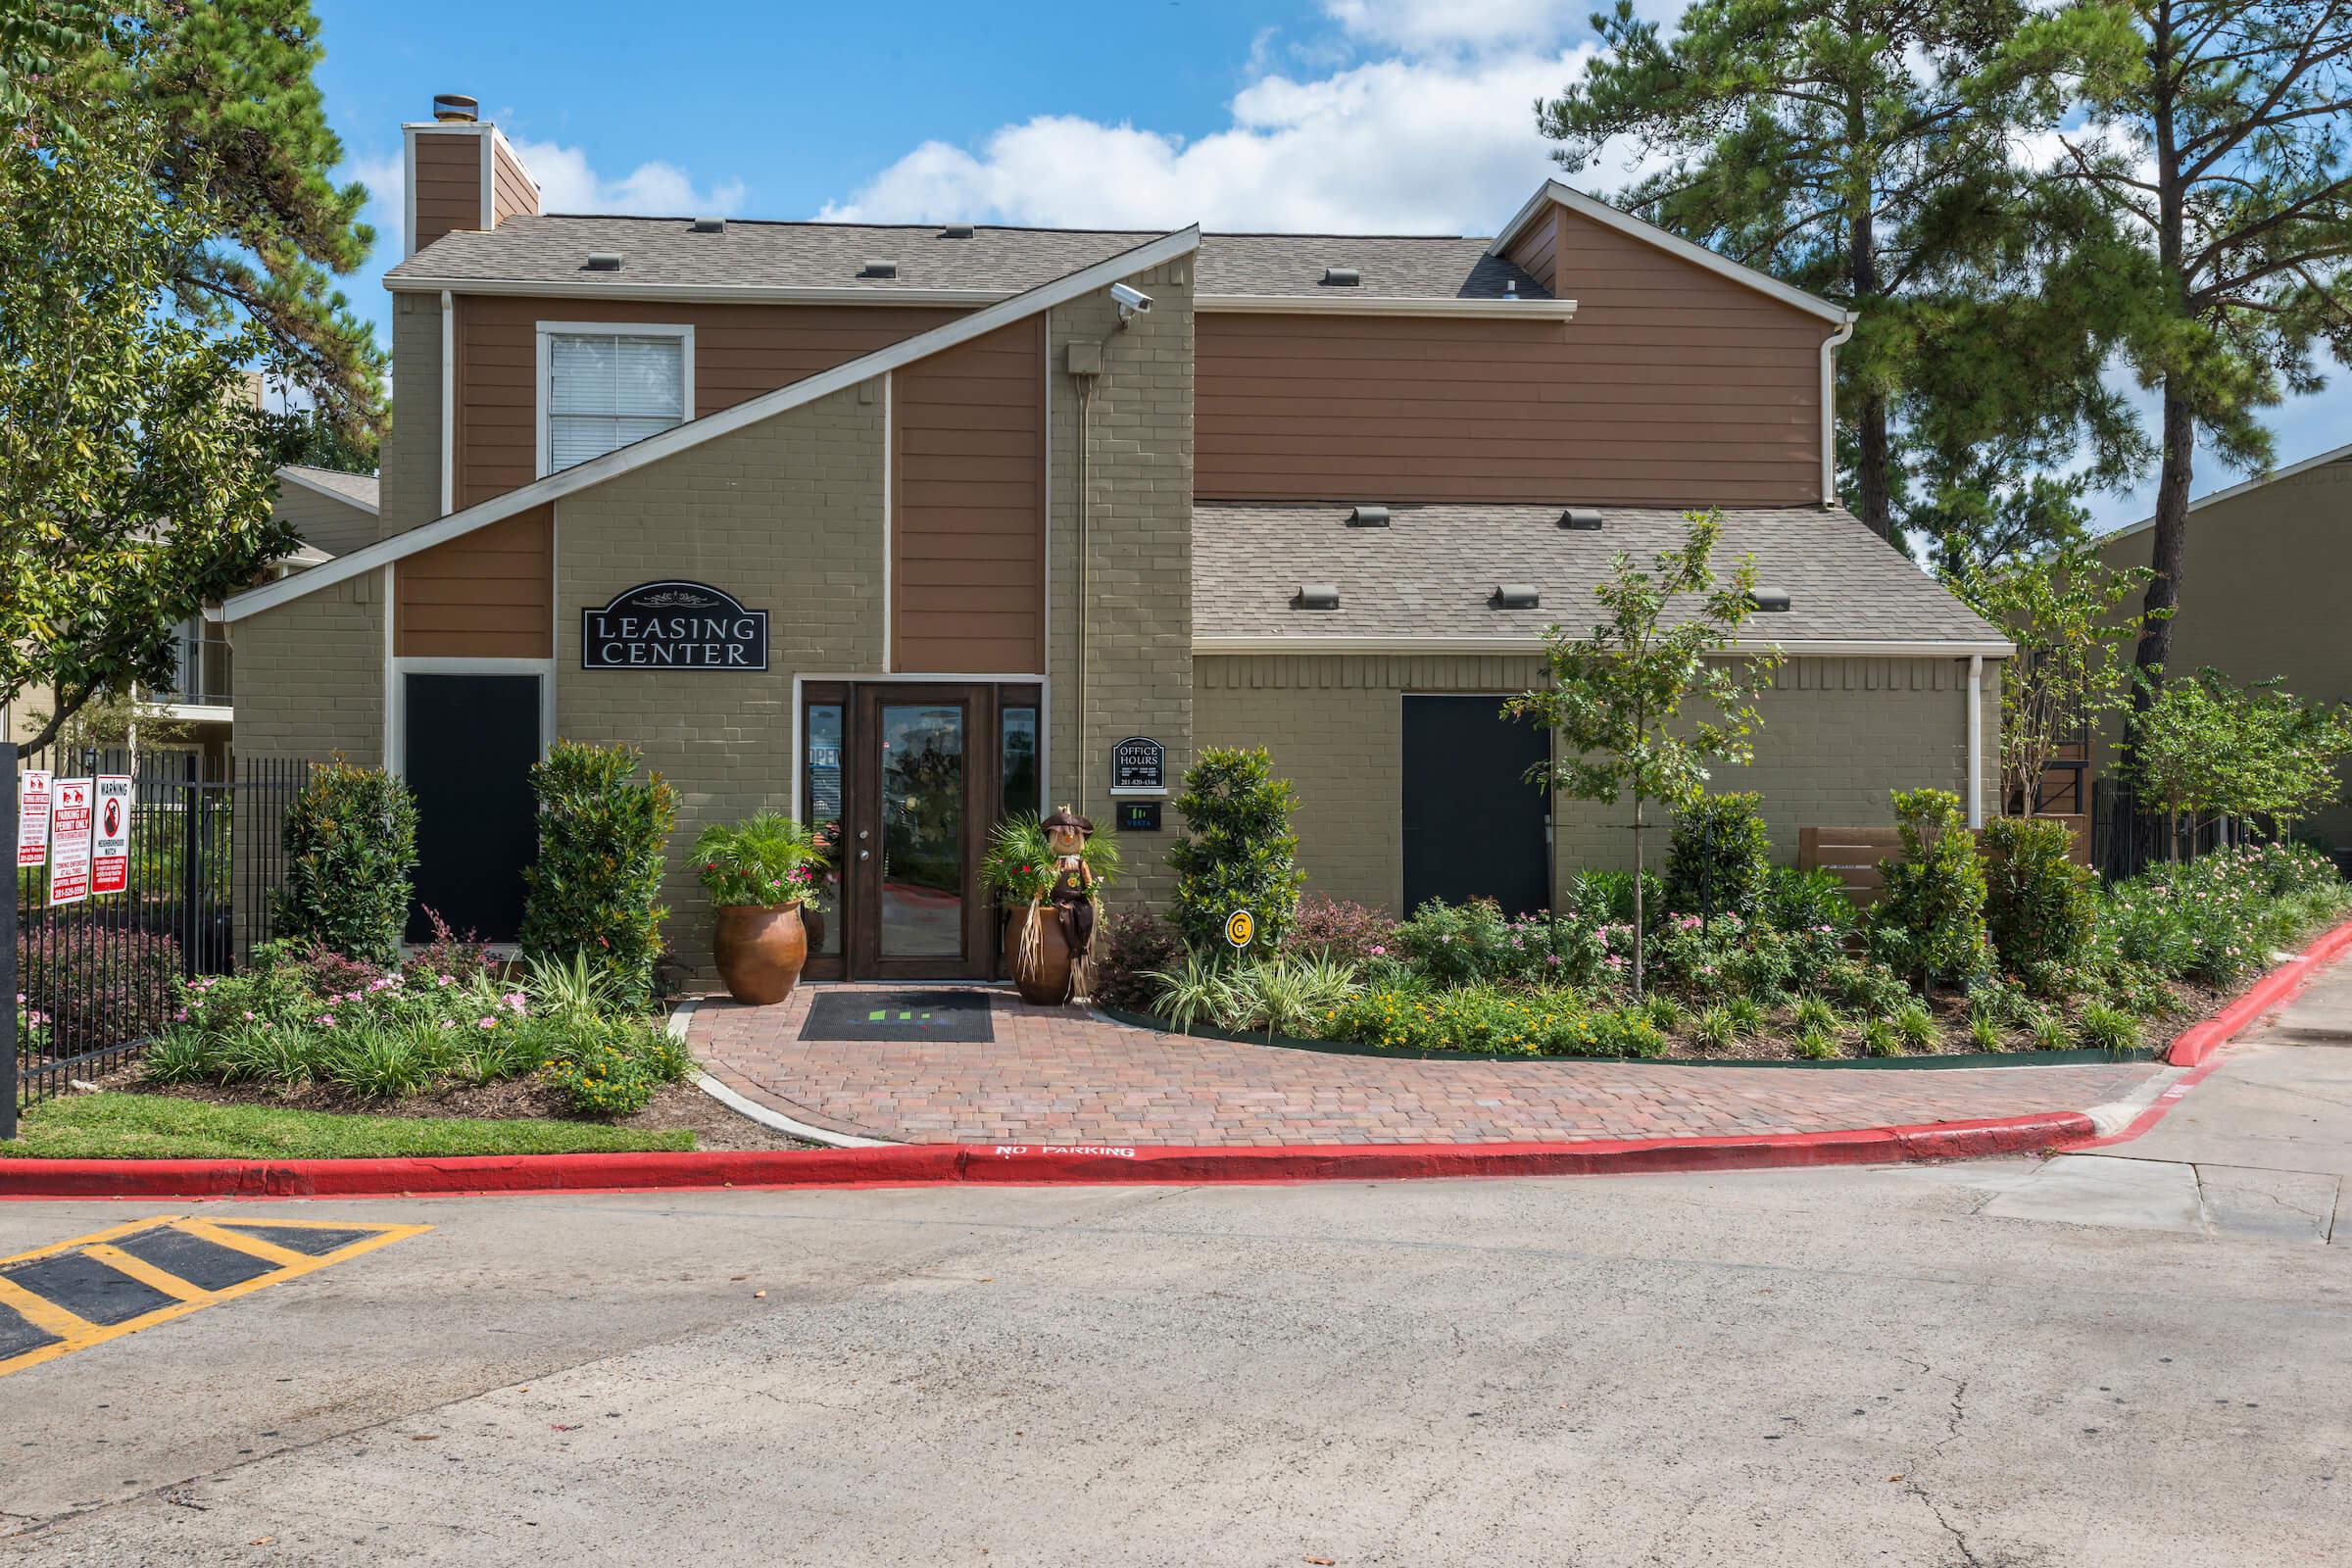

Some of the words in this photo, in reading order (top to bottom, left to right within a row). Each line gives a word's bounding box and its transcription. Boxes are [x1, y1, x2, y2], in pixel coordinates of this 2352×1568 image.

[597, 617, 755, 640] LEASING
[601, 643, 749, 665] CENTER
[1120, 746, 1158, 756] OFFICE
[1120, 756, 1158, 765] HOURS
[101, 782, 127, 796] WARNING
[57, 808, 79, 820] PARKING
[80, 808, 88, 818] BY
[56, 819, 74, 832] PERMIT
[75, 818, 88, 830] ONLY
[105, 847, 117, 856] WATCH
[996, 1146, 1027, 1155] NO
[1042, 1146, 1136, 1157] PARKING
